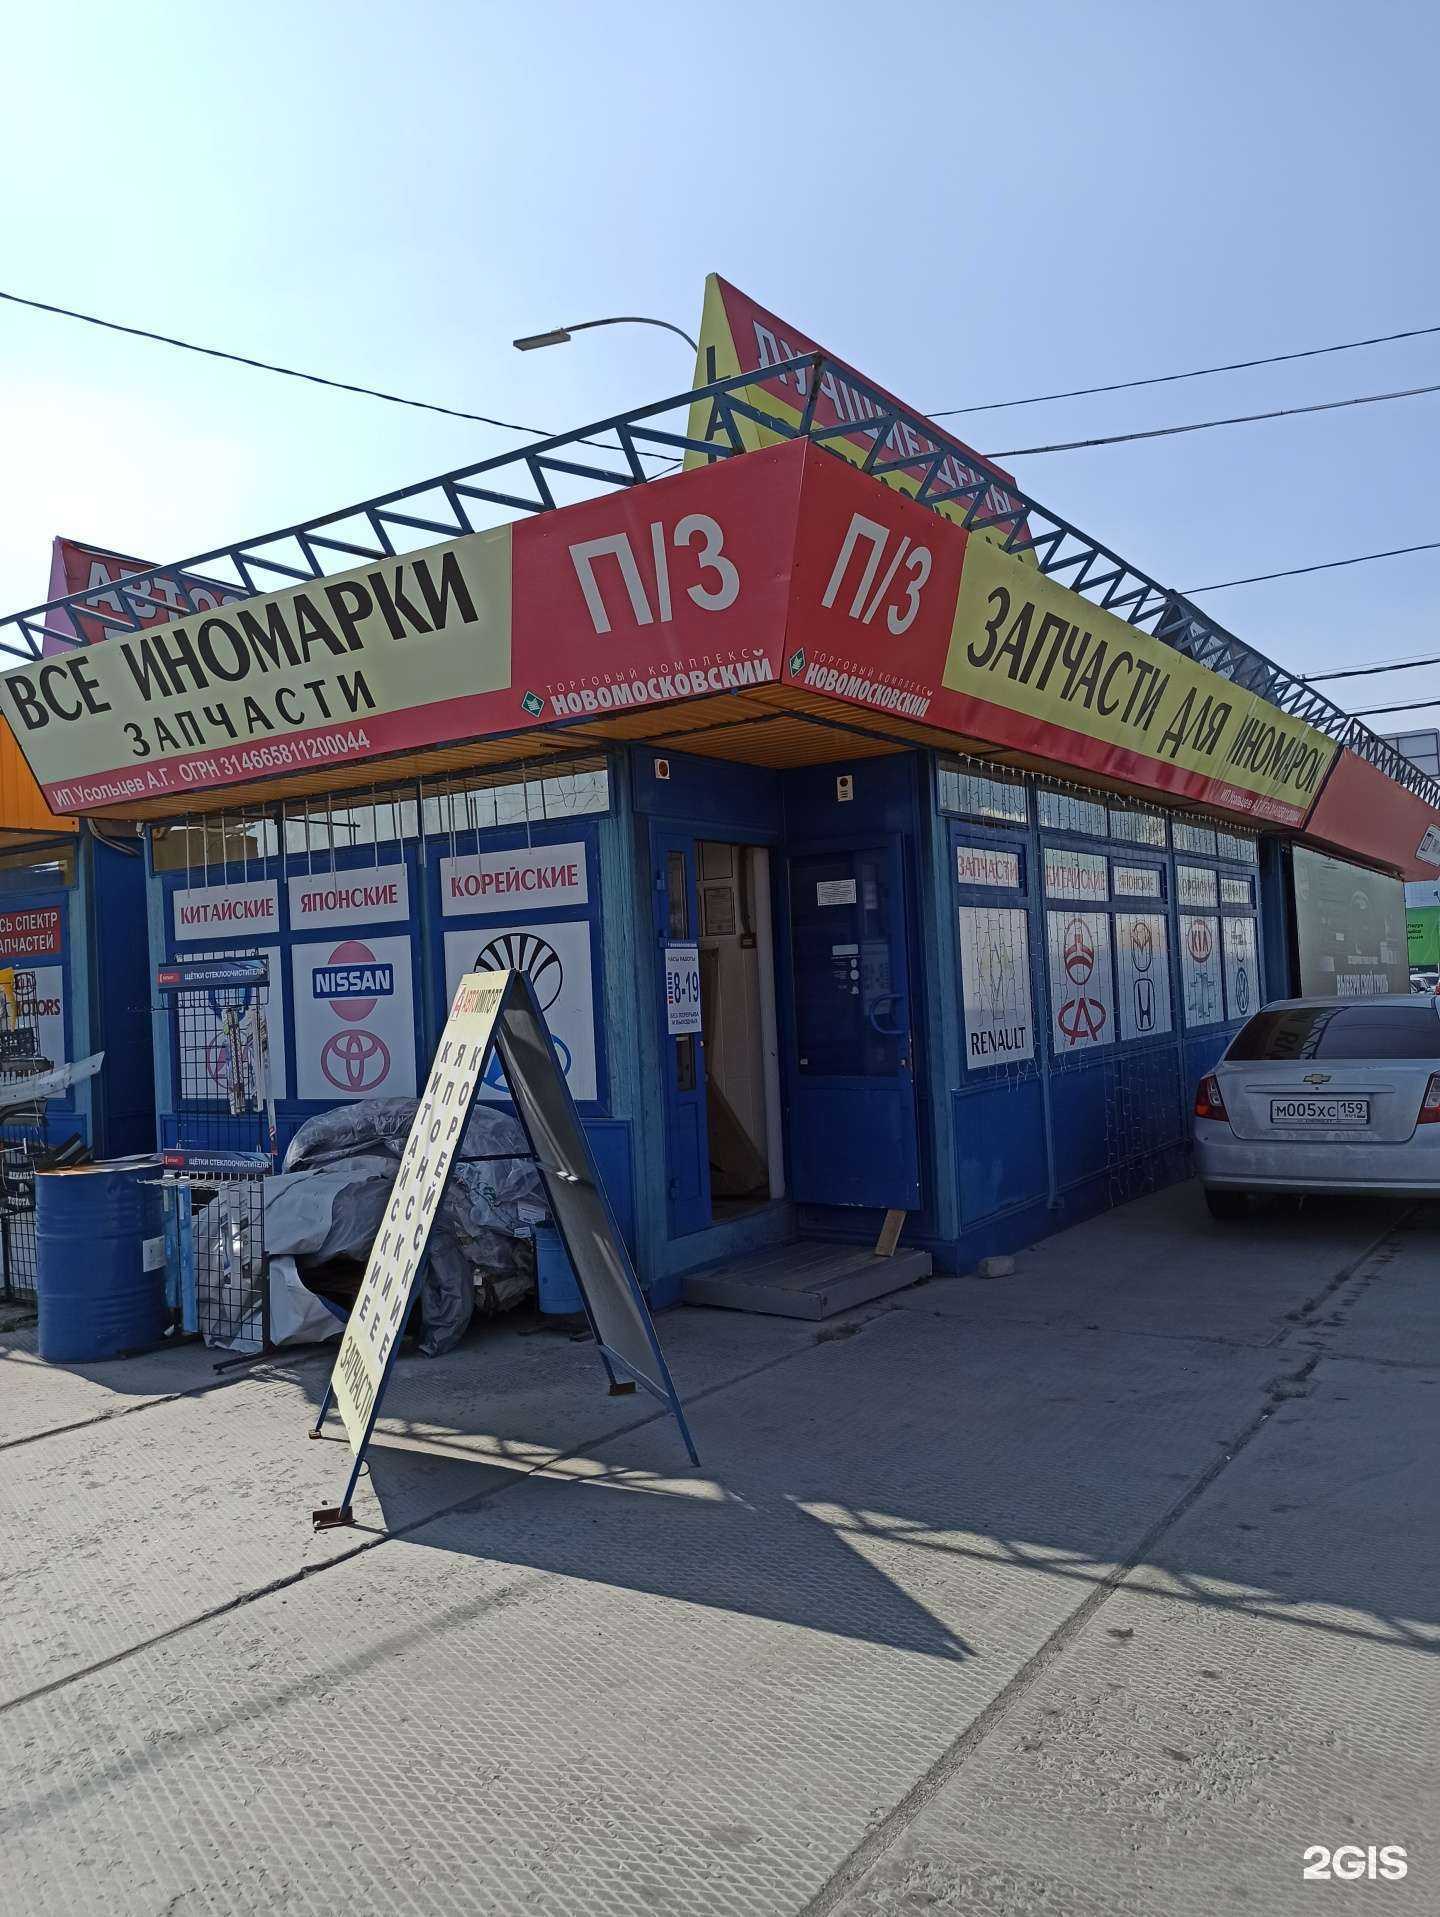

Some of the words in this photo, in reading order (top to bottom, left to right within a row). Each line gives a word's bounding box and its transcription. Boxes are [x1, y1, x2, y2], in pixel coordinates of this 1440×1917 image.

[86, 560, 246, 623] АВТО
[4, 655, 113, 730] ВСЕ
[121, 551, 480, 701] ИНОМАРКИ
[546, 667, 638, 693] ТОРГОВЫЙ
[648, 648, 750, 675] КОМПЛЕКС
[550, 649, 774, 716] НОВОМОСКОВСКИЙ
[804, 663, 933, 718] НОВОМОСКОВСКИЙ
[814, 650, 874, 676] ТОРГОВЫЙ
[878, 672, 929, 693] КОМПЛЕКС
[967, 586, 1171, 731] ЗАПЧАСТИ
[1157, 686, 1233, 758] ДЛЯ
[1226, 714, 1326, 794] ИНОМАРОК
[124, 671, 376, 757] ЗАПЧАСТИ
[52, 788, 76, 808] ИП
[75, 775, 145, 805] Усольцев
[147, 766, 174, 789] А.Г.
[179, 757, 217, 783] ОГРН
[450, 864, 578, 897] КОРЕЙСКИЕ
[958, 855, 1018, 881] ЗАПЧАСТИ
[181, 897, 275, 924] КИТАЙСКИЕ
[300, 884, 398, 913] ЯПОНСКИЕ
[15, 911, 58, 931] СПЕКТР
[204, 967, 265, 980] СТЕКЛООЧИСТИТЕЛЯ
[315, 970, 391, 993] NISSAN
[970, 1027, 1026, 1056] RENAULT
[1277, 1102, 1336, 1117] М005ХС
[1340, 1102, 1363, 1114] 159
[189, 1157, 209, 1166] ЩЁТКИ
[209, 1158, 269, 1168] СТЕКЛООЧИСТИТЕЛЯ
[359, 1041, 452, 1323] КИТАЙСКИЕ
[369, 1044, 467, 1343] ЯПОНСКИЕ
[378, 1046, 483, 1365] КОРЕЙСКИЕ
